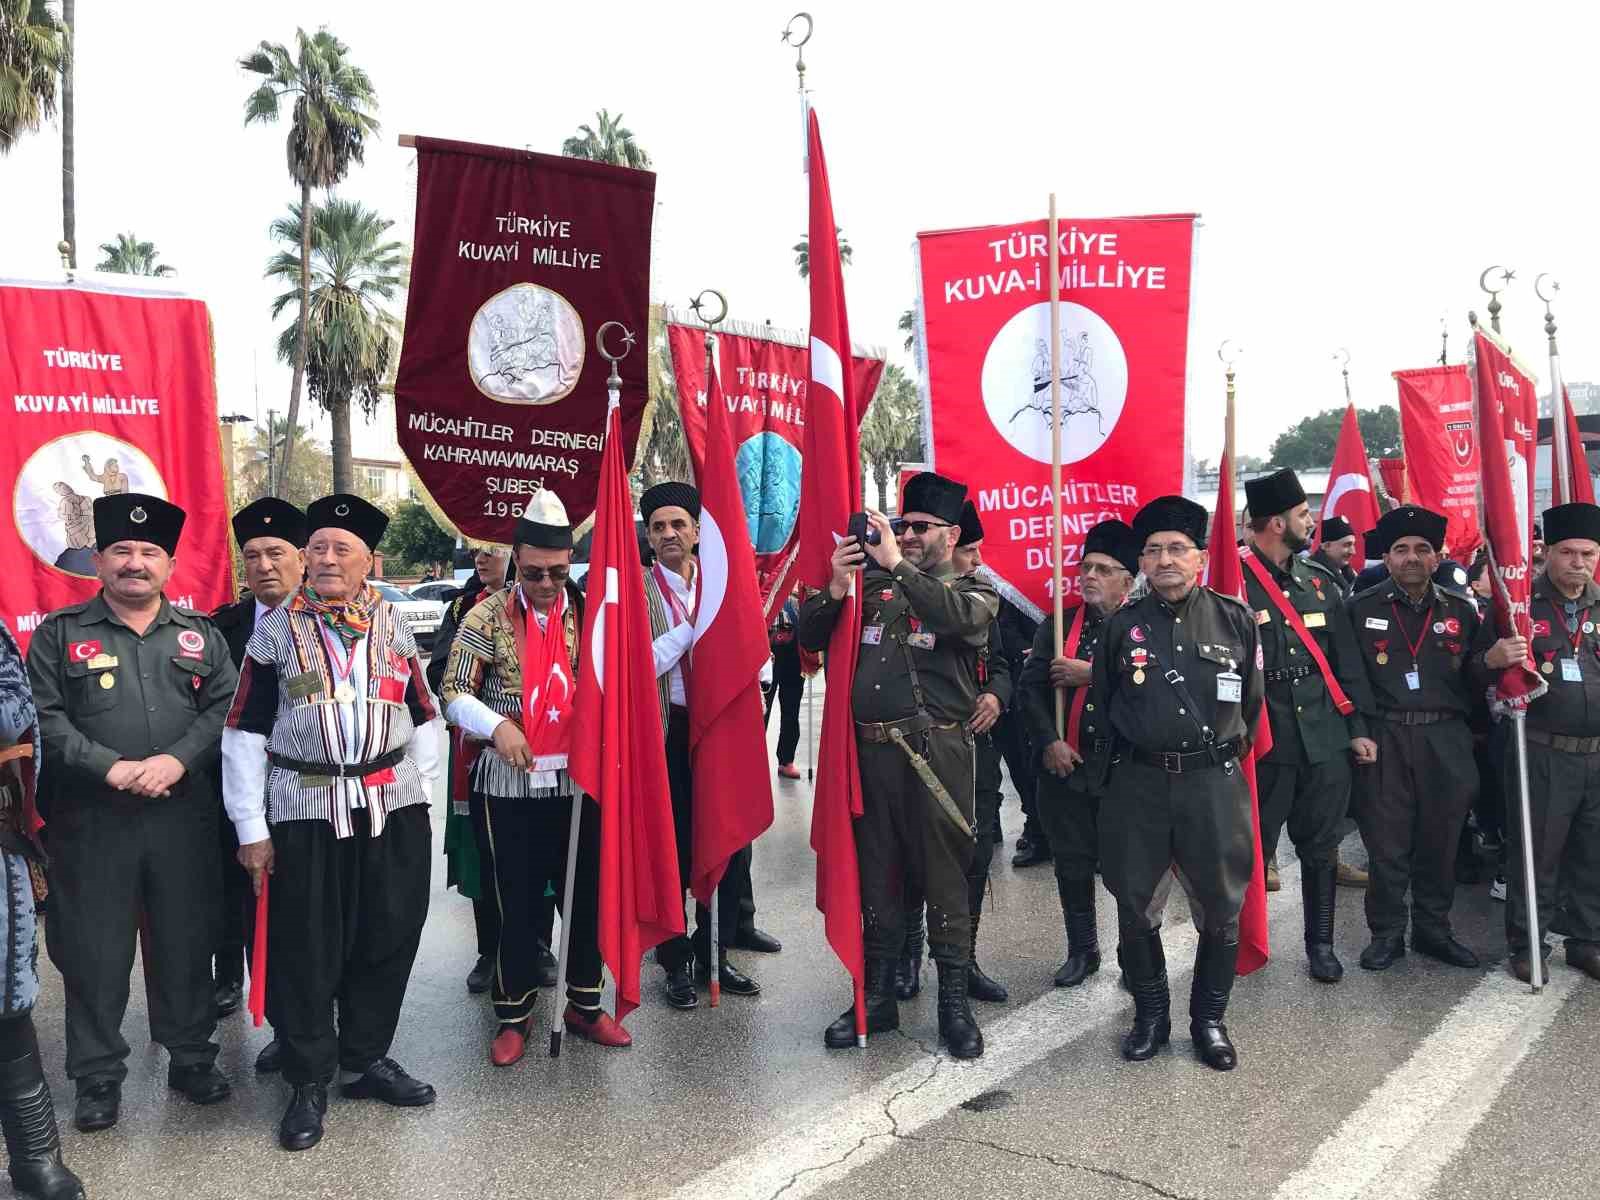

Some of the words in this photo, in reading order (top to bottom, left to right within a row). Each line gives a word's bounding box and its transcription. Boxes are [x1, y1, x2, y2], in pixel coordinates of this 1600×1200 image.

[495, 211, 572, 238] TÜRKİYE
[458, 240, 519, 261] KUVAYİ
[532, 245, 602, 269] MİLLİYE
[988, 226, 1118, 263] TÜRKİYE
[944, 262, 1041, 304] KUVA-İ
[1056, 259, 1166, 290] MİLLİYE
[43, 347, 123, 372] TÜRKİYE
[14, 391, 90, 414] KUVAYİ
[92, 394, 160, 416] MİLLİYE
[696, 389, 767, 416] KVAYİ
[408, 411, 515, 443] MÜCAHİTLER
[423, 443, 580, 480] KAHRAMANMARAŞ
[485, 475, 545, 496] ŞUBESİ
[978, 478, 1139, 512] MÜCAHİTLER
[482, 499, 525, 518] 195
[1044, 575, 1081, 600] 195
